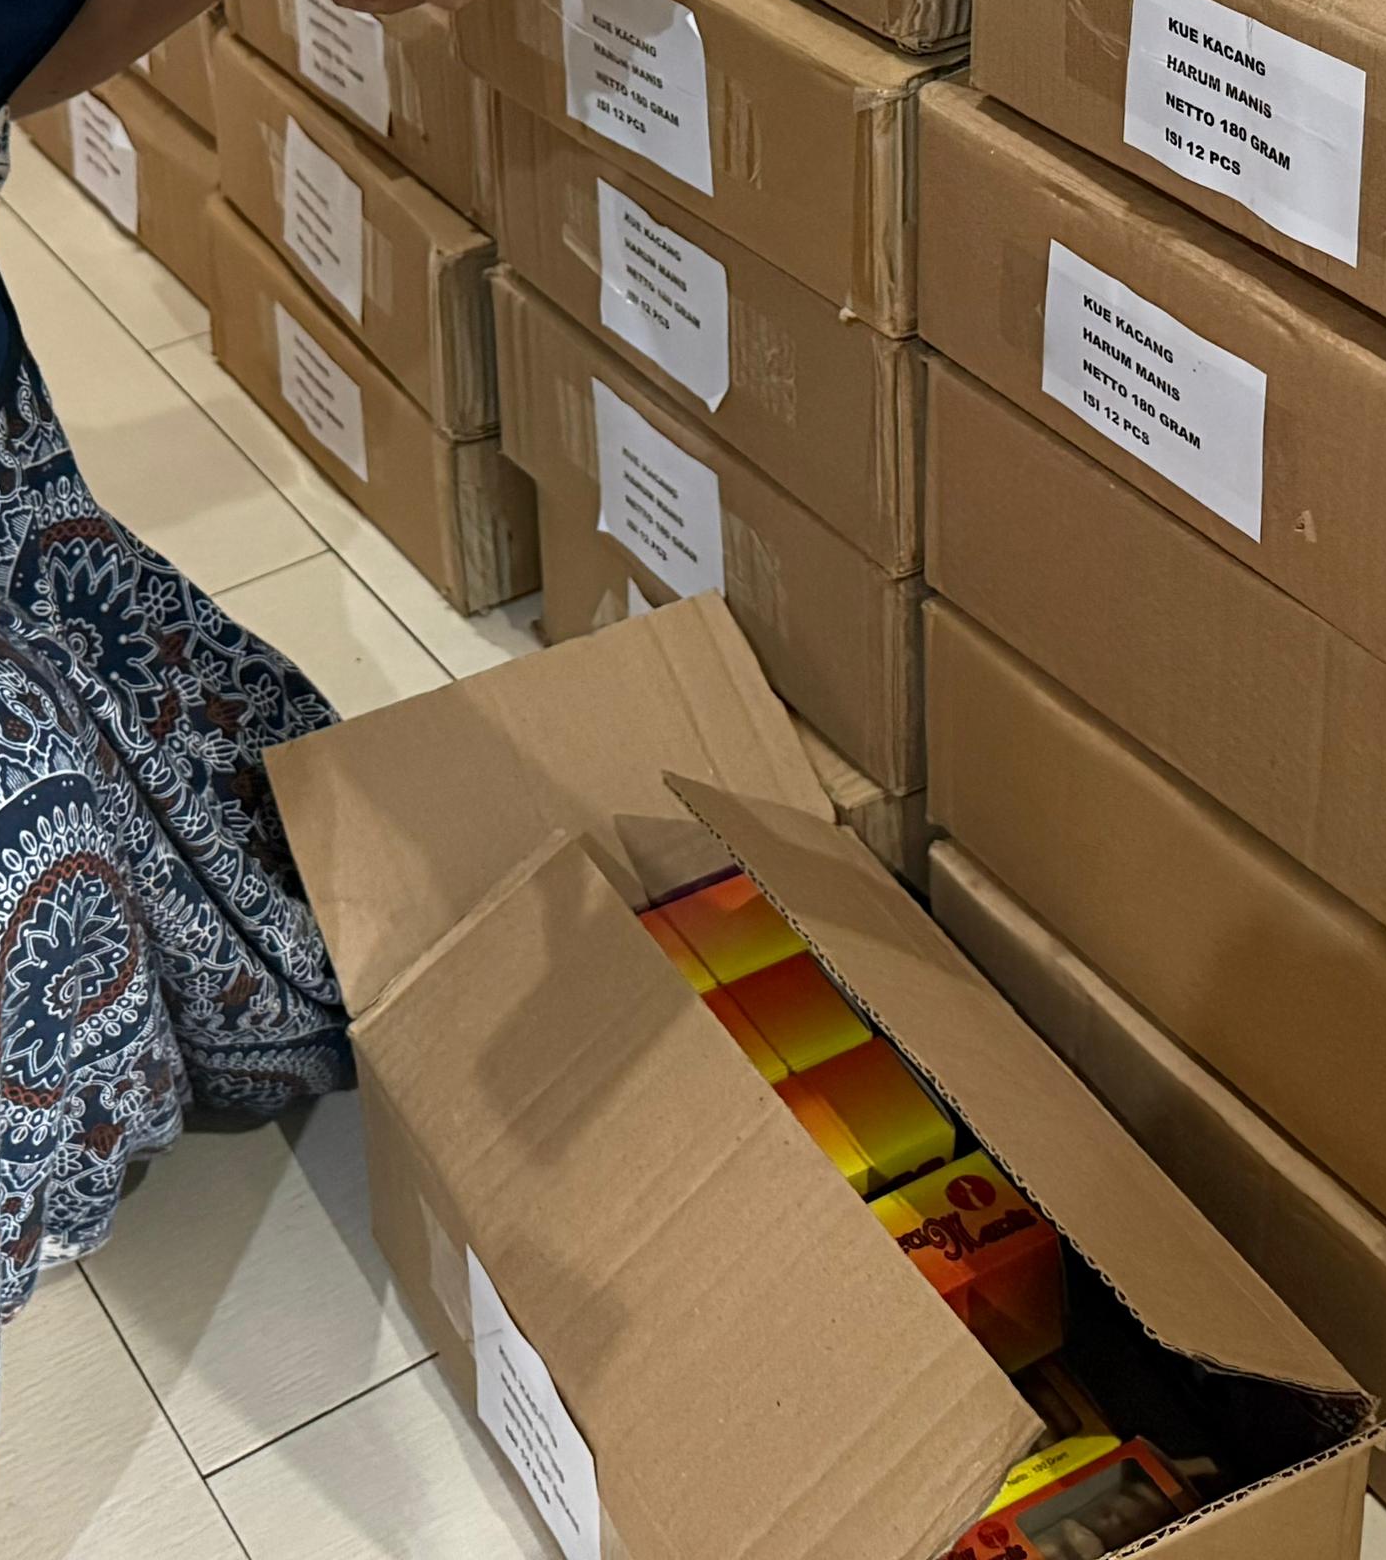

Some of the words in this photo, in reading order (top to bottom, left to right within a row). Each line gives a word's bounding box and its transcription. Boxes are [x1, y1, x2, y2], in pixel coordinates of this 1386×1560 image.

[615, 26, 657, 58] KACANG
[1169, 17, 1199, 44] KUE
[1203, 34, 1265, 76] KACANG
[650, 101, 679, 127] GRAM
[1167, 54, 1220, 92] HARUM
[1226, 83, 1272, 118] MANIS
[613, 107, 625, 122] 12
[627, 114, 646, 134] PCS
[1166, 92, 1213, 126] NETTO
[1220, 120, 1247, 141] 180
[1251, 136, 1290, 170] GRAM
[1165, 128, 1181, 149] ISI
[1187, 142, 1204, 160] 12
[1210, 151, 1241, 176] PCS
[1084, 294, 1111, 322] KUE
[1116, 316, 1173, 363] KACANG
[1083, 328, 1131, 370] HARUM
[1136, 362, 1180, 401] MANIS
[1083, 360, 1127, 398] NETTO
[1132, 394, 1155, 417] 180
[1159, 413, 1201, 449] GRAM
[1083, 391, 1099, 412] ISI
[1105, 405, 1119, 426] 12
[1123, 419, 1150, 445] PCS
